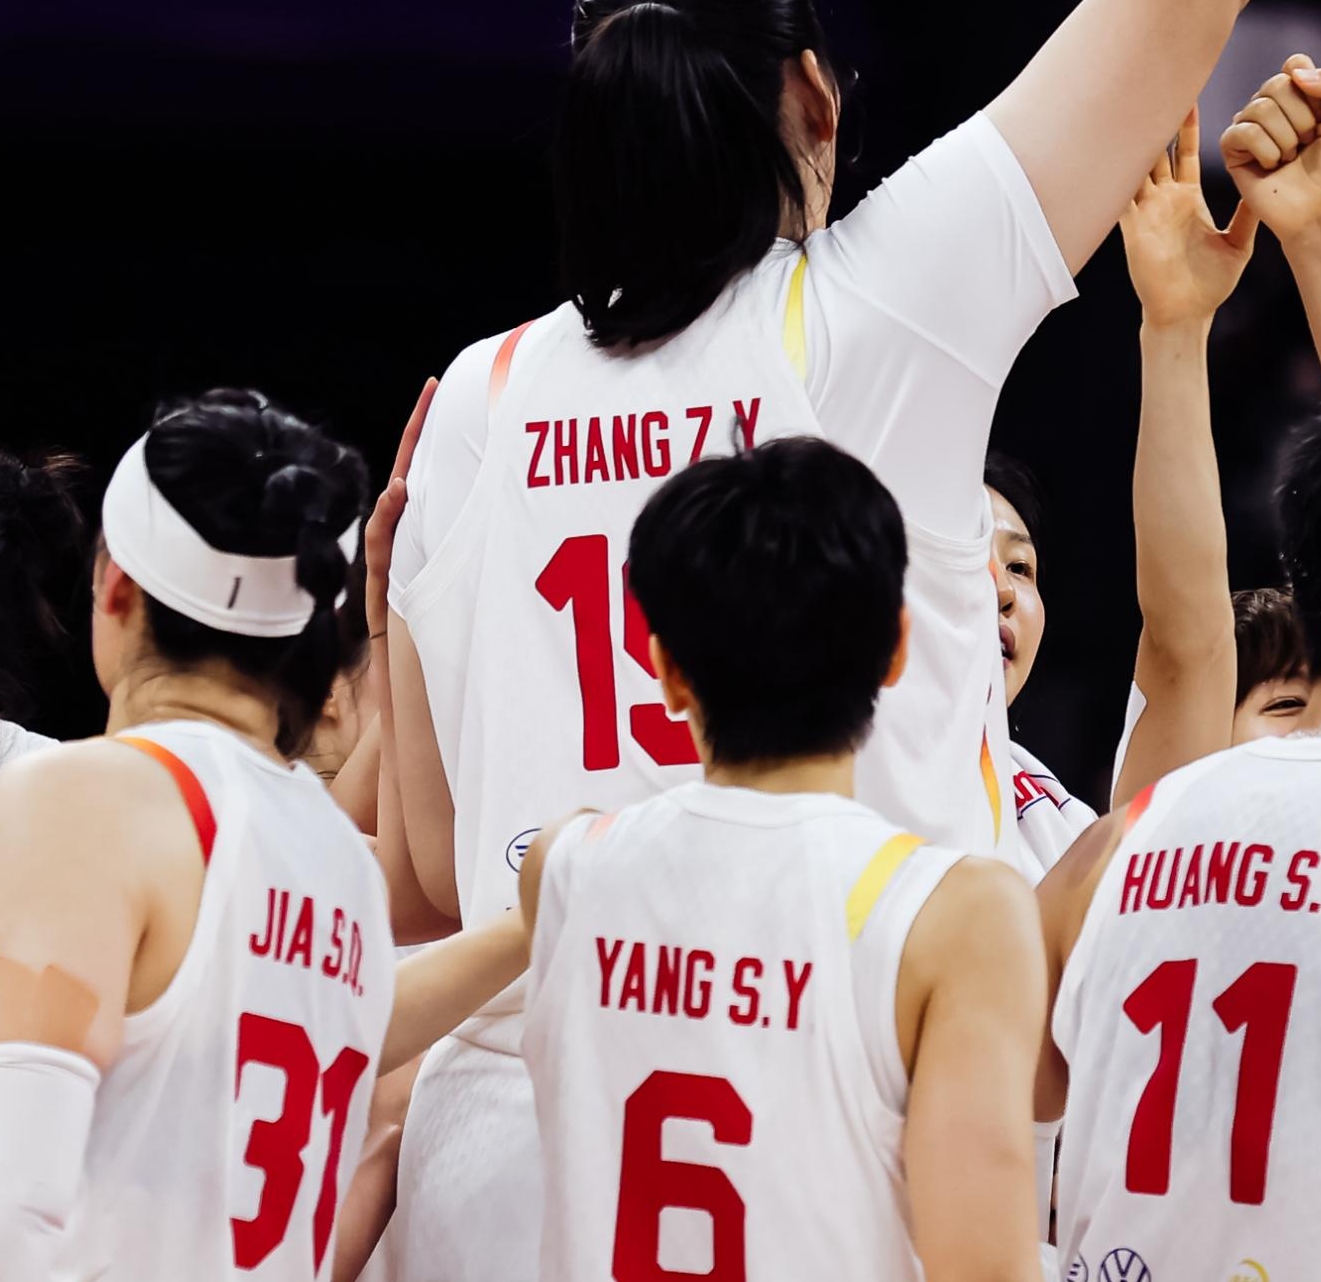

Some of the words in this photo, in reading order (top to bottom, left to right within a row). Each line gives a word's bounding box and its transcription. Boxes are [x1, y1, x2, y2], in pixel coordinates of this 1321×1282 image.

[525, 410, 672, 489] ZHANG
[1119, 841, 1276, 915] HUANG
[248, 887, 315, 968] JIA
[595, 936, 716, 1020] YANG
[1121, 958, 1300, 1206] 11
[229, 1011, 370, 1281] 31
[610, 1069, 754, 1282] 6
